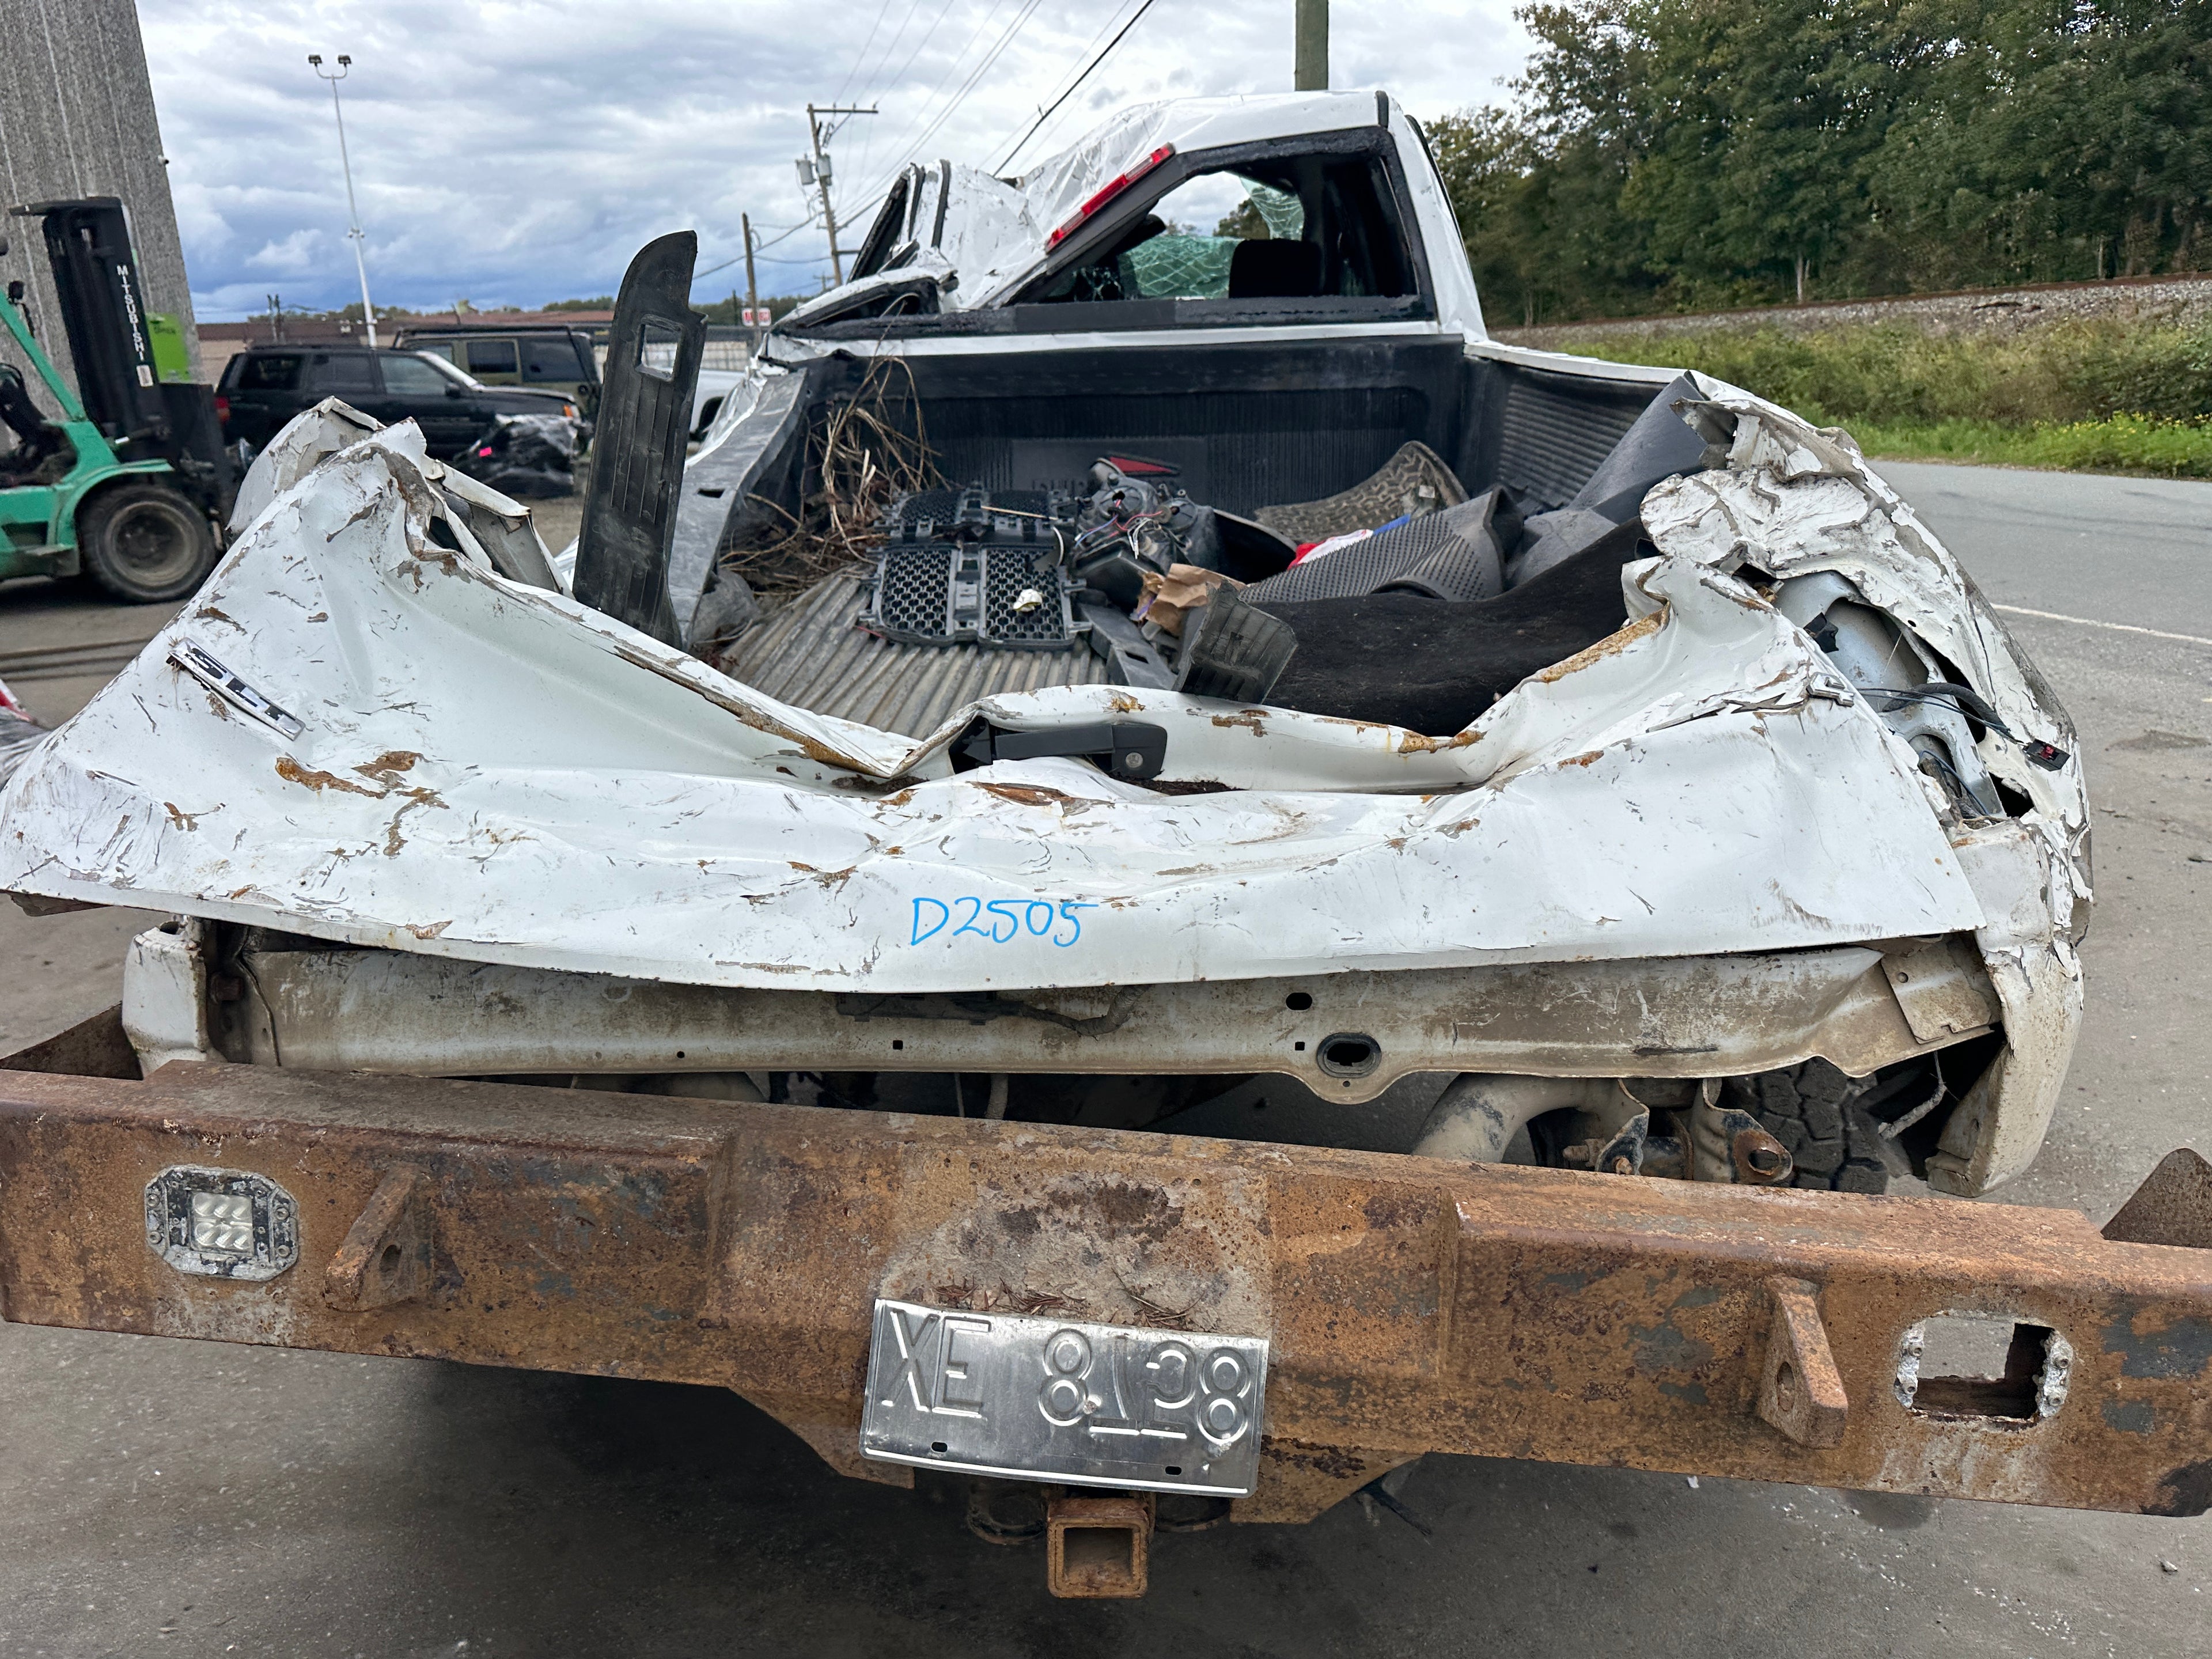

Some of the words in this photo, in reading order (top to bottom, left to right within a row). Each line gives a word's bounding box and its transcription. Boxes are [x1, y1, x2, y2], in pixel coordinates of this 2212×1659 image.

[116, 264, 145, 361] MITSUBISHI
[184, 647, 297, 721] SLT
[911, 896, 1099, 947] D2505
